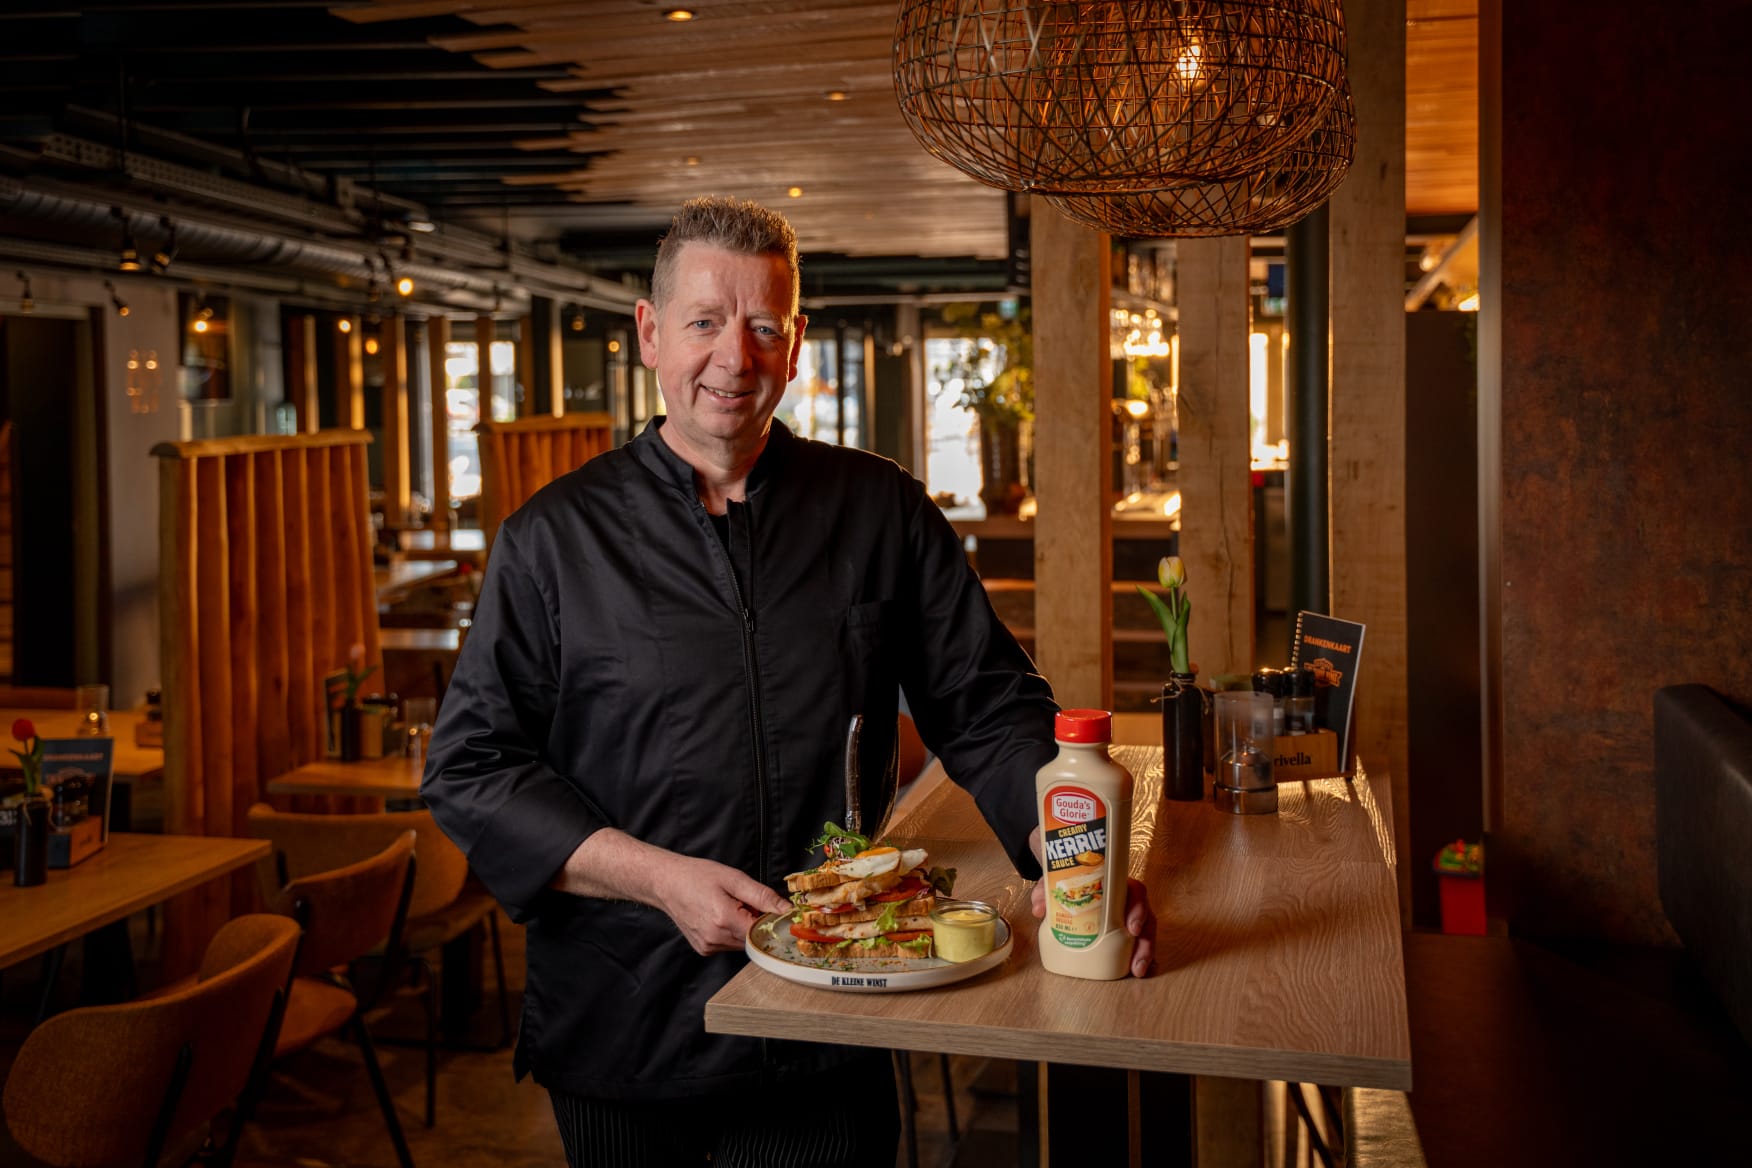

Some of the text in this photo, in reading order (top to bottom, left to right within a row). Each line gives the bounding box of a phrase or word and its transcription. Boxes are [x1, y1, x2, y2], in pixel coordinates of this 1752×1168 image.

[1303, 635, 1352, 653] DRANKENKAART
[1274, 752, 1311, 766] rivella
[1056, 798, 1091, 810] Gouda's
[1060, 808, 1087, 819] Glorie
[1058, 824, 1087, 837] CREAMY
[1046, 829, 1106, 860] KERRIE
[1051, 857, 1075, 870] SAUCE
[832, 976, 887, 987] DE KLEINE WINST
